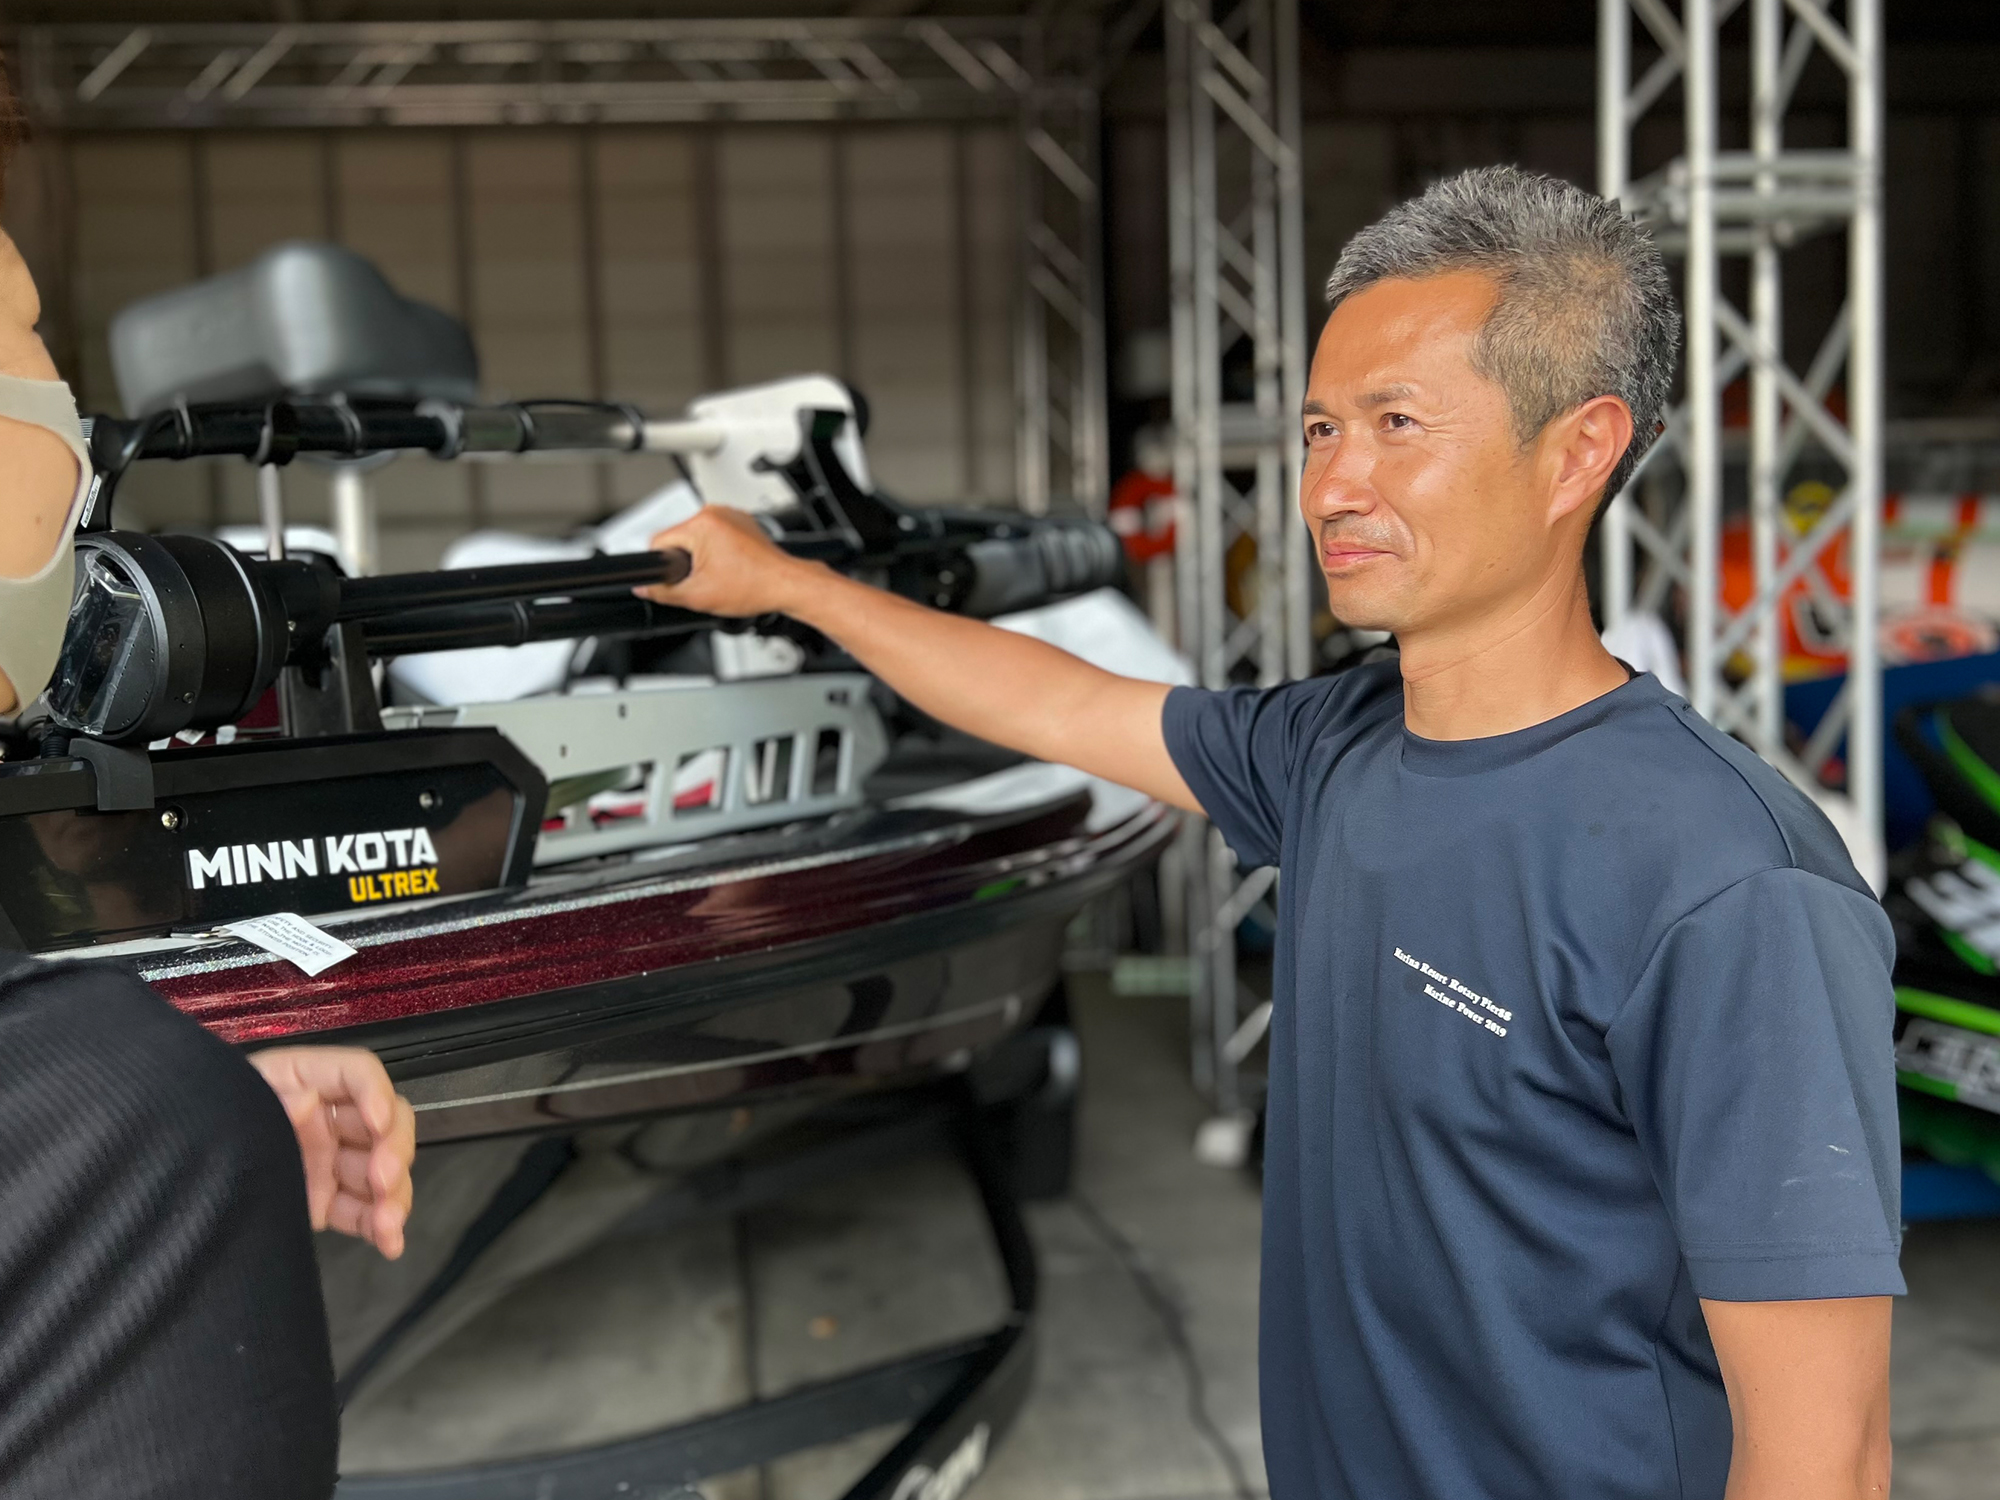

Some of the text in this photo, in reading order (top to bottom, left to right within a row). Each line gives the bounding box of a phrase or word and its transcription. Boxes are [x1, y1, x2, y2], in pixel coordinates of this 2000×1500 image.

[187, 827, 439, 889] MINN KOTA
[349, 868, 440, 902] ULTREX
[1419, 962, 1449, 985] Resort
[1448, 978, 1482, 1005] Rotary
[1423, 983, 1508, 1038] Marine Power 2019
